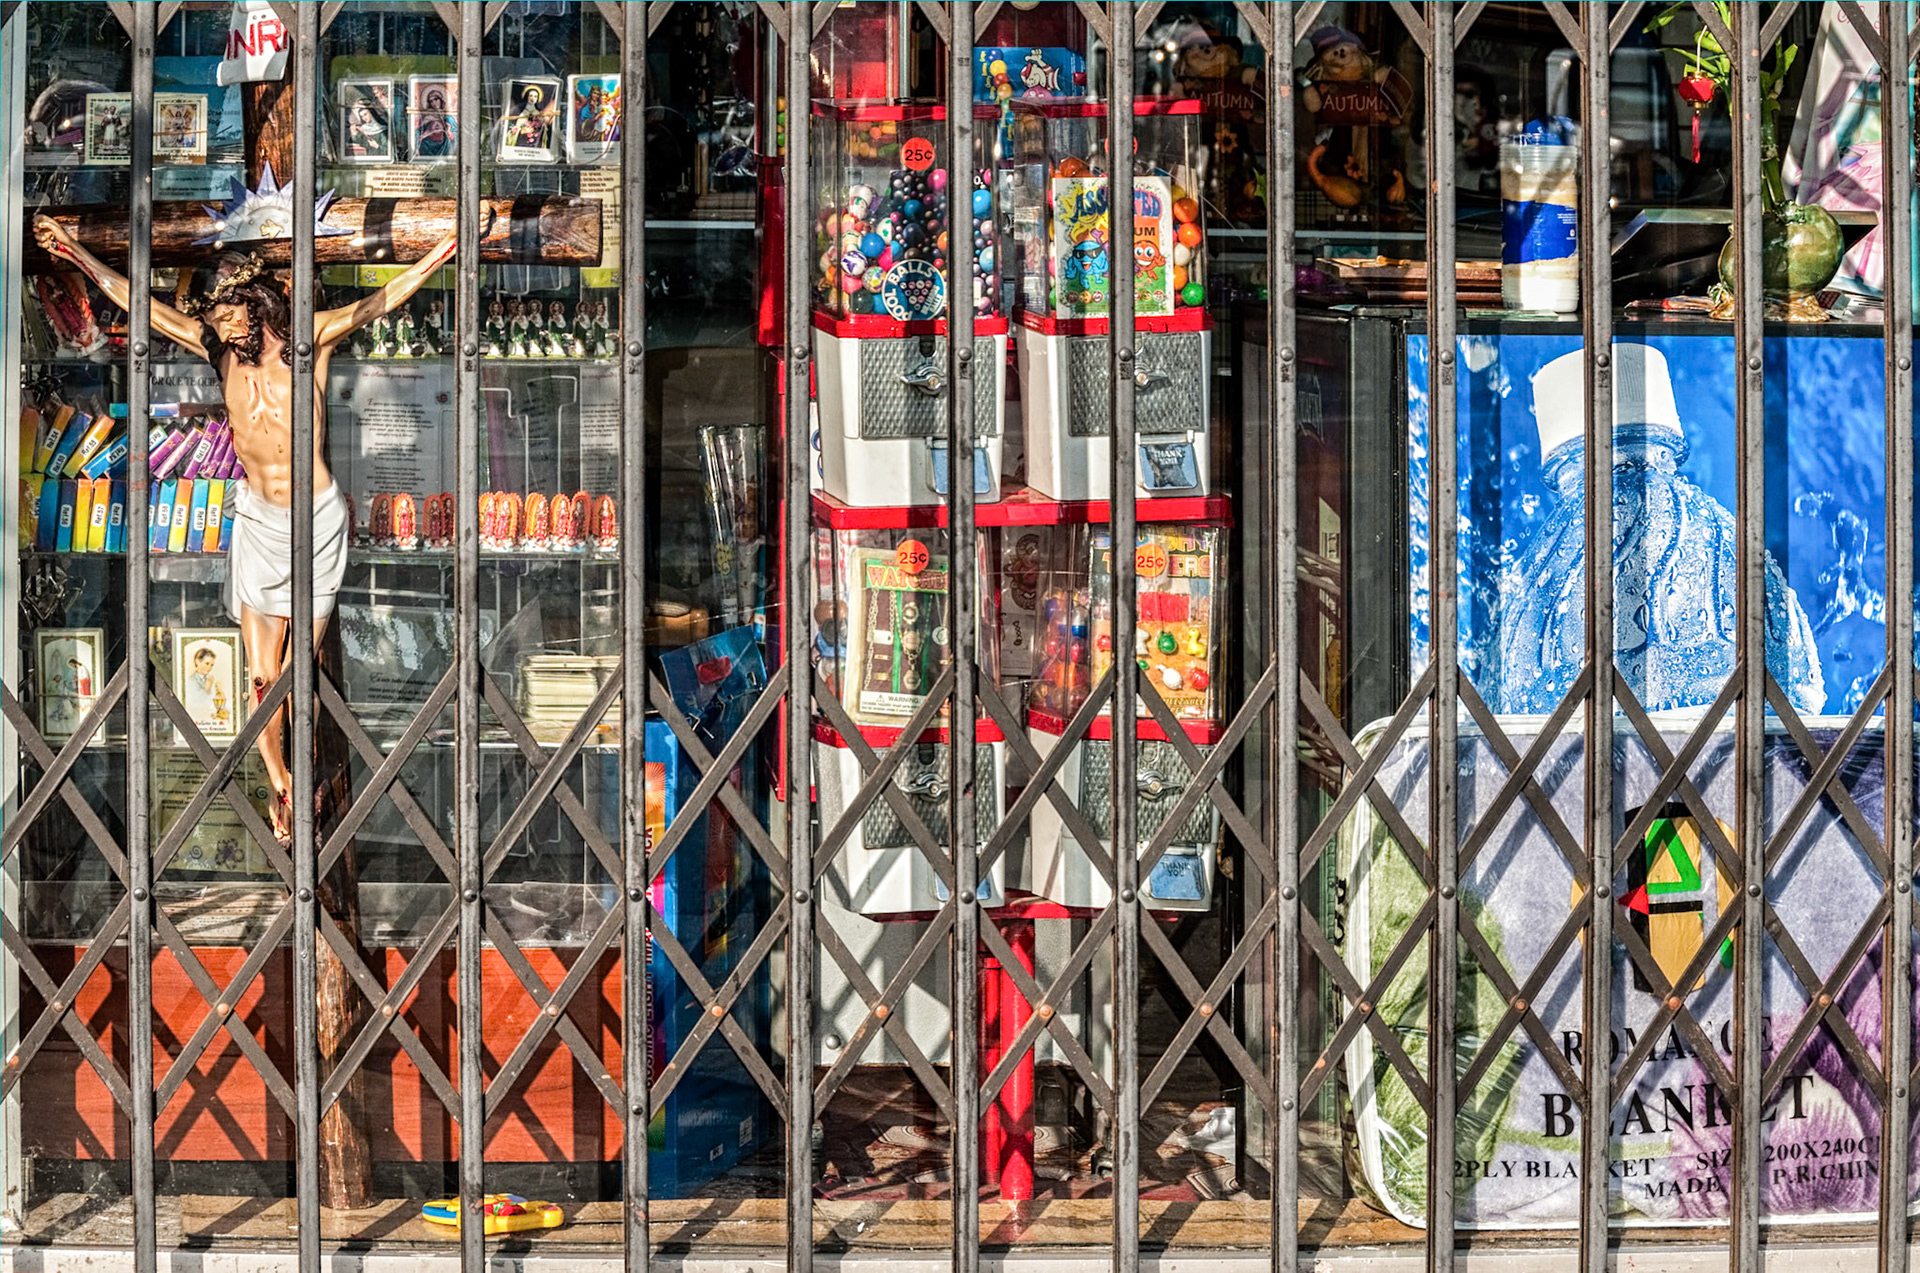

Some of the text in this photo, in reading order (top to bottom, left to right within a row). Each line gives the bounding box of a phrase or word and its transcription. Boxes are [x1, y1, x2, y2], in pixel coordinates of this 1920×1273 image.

[227, 19, 288, 60] INRI
[1323, 94, 1391, 112] AUTUMN
[905, 149, 933, 162] 25¢
[1069, 186, 1162, 223] ASSTED
[885, 261, 936, 321] POOL BALLS
[152, 376, 163, 386] OR
[900, 552, 928, 566] 25¢
[1137, 555, 1164, 569] 25¢
[1540, 1075, 1814, 1138] BANKT
[1454, 1135, 1880, 1178] 2PLY BLAKET SIZ 200X240C
[1645, 1159, 1879, 1200] MADE P.R.CHIN
